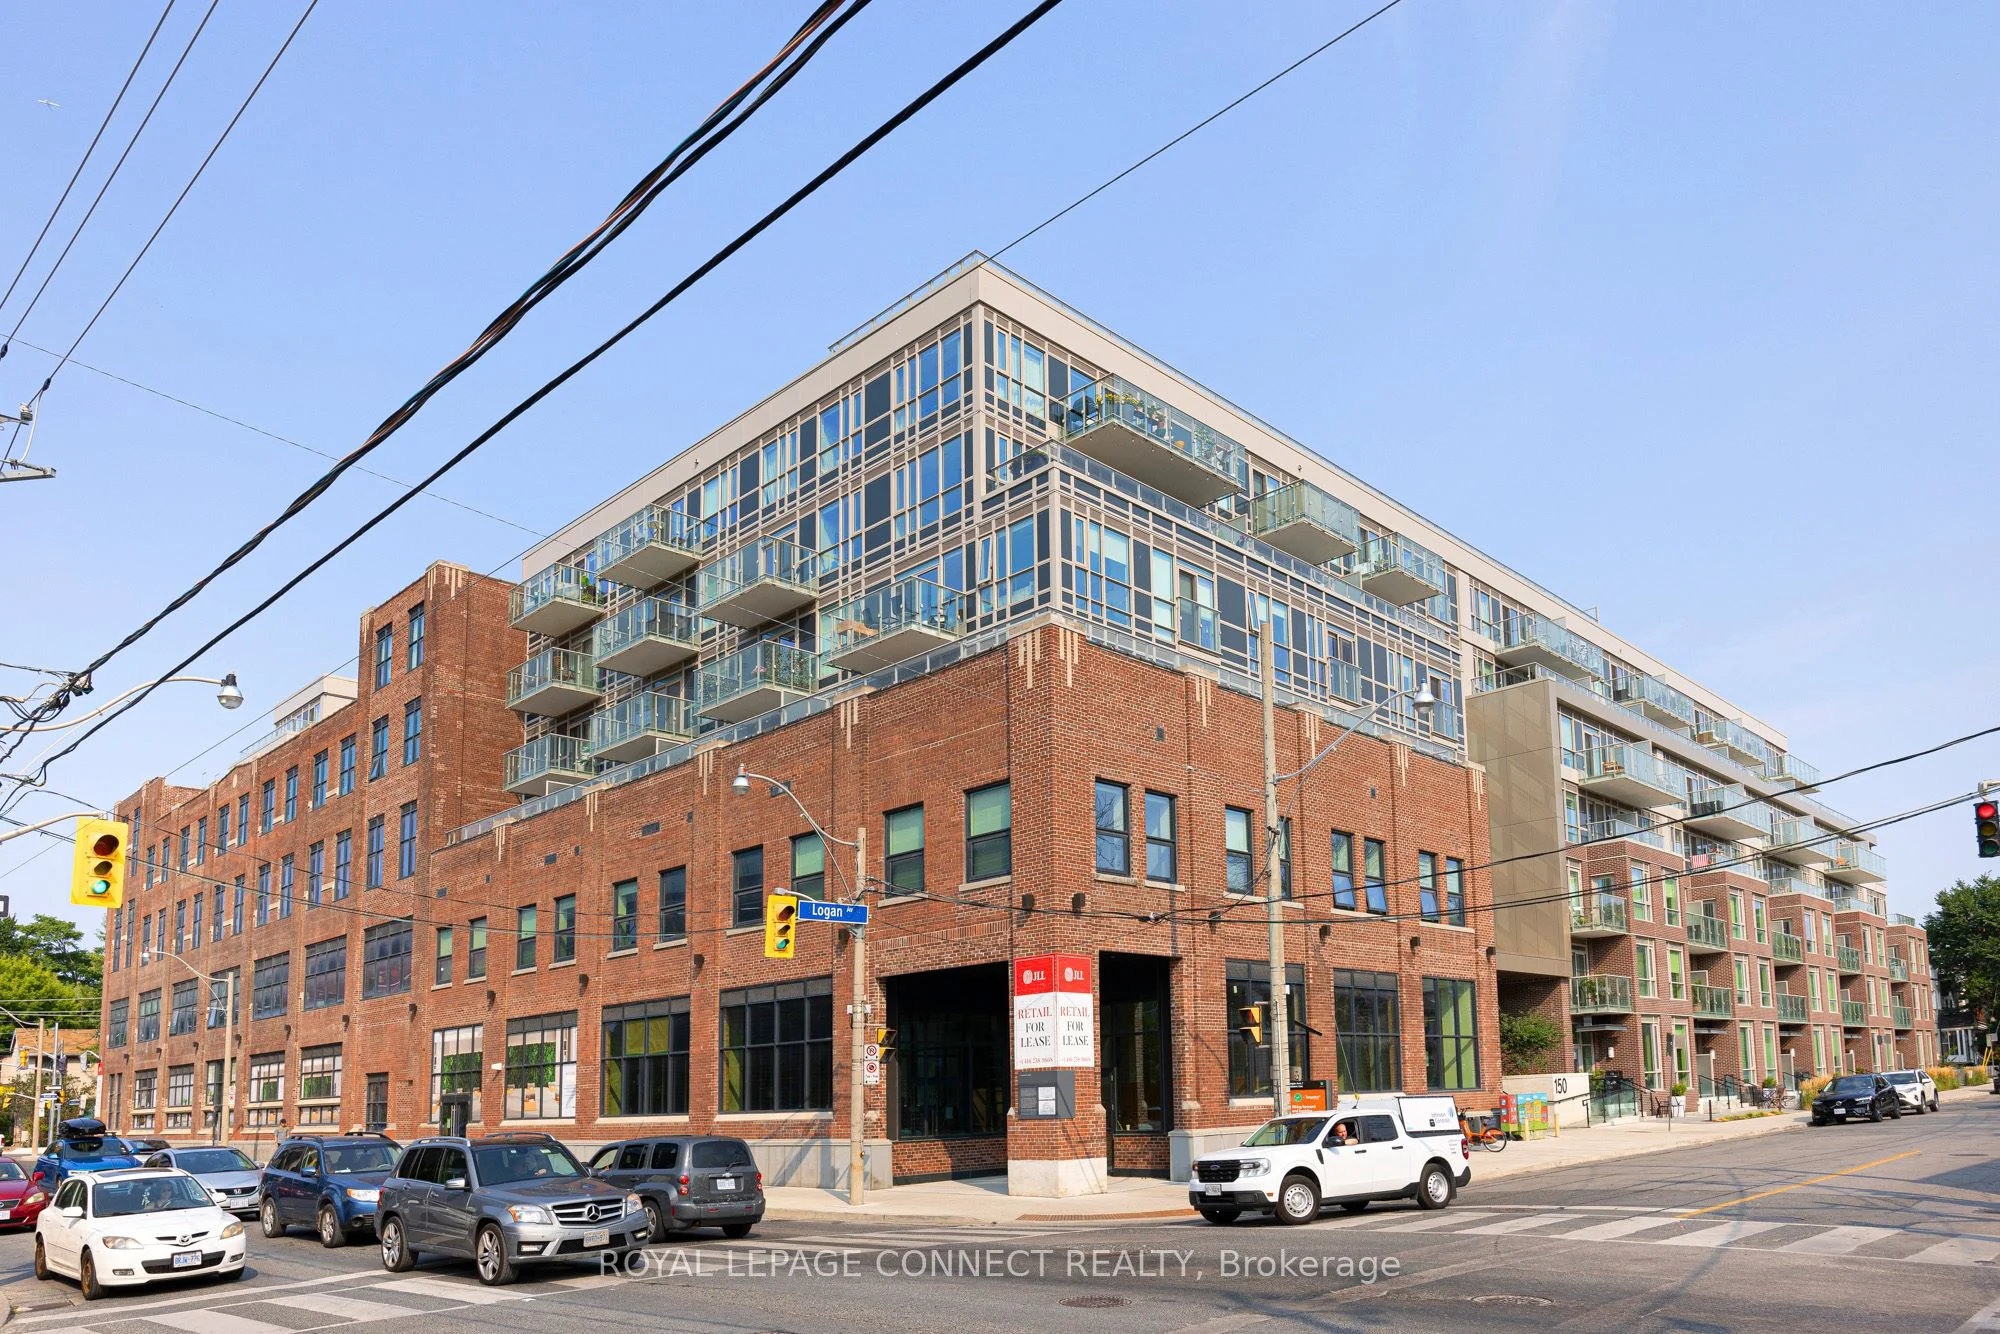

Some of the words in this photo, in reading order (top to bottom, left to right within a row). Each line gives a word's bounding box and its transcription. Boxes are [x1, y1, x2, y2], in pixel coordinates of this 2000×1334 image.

[812, 903, 843, 919] Logan
[1033, 970, 1046, 981] JLL
[1073, 970, 1085, 980] JLL
[1018, 1006, 1053, 1019] RETAIL
[1060, 1006, 1090, 1018] RETAIL
[1025, 1021, 1045, 1033] FOR
[1067, 1021, 1084, 1032] FOR
[1020, 1035, 1051, 1048] LEASE
[1062, 1035, 1089, 1046] LEASE
[1554, 1078, 1568, 1094] 150
